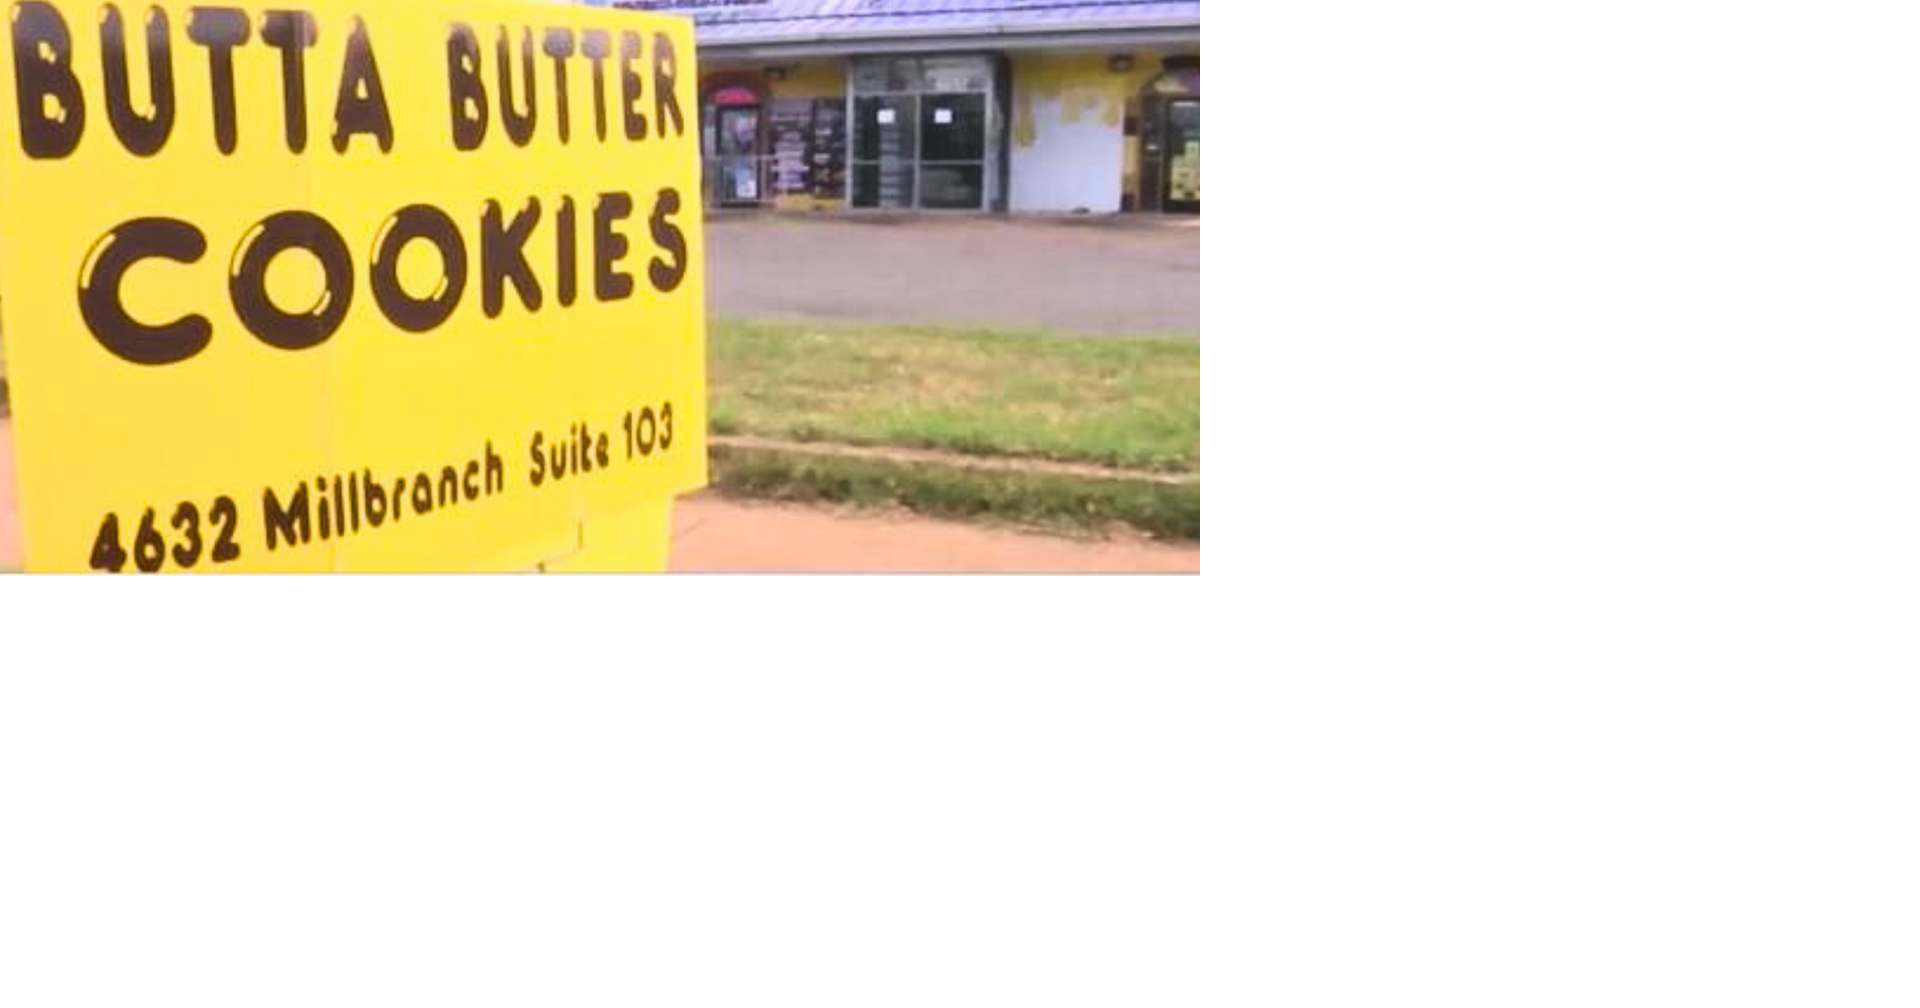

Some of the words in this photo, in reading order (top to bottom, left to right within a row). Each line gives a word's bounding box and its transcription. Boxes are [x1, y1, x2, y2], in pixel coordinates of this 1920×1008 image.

[11, 0, 394, 161] BUTTA
[447, 22, 685, 152] BUTTER
[78, 188, 688, 366] COOKIES
[89, 495, 241, 573] 4632
[262, 442, 503, 551] Millbranch
[529, 424, 609, 487] Suite
[623, 402, 673, 458] 103
